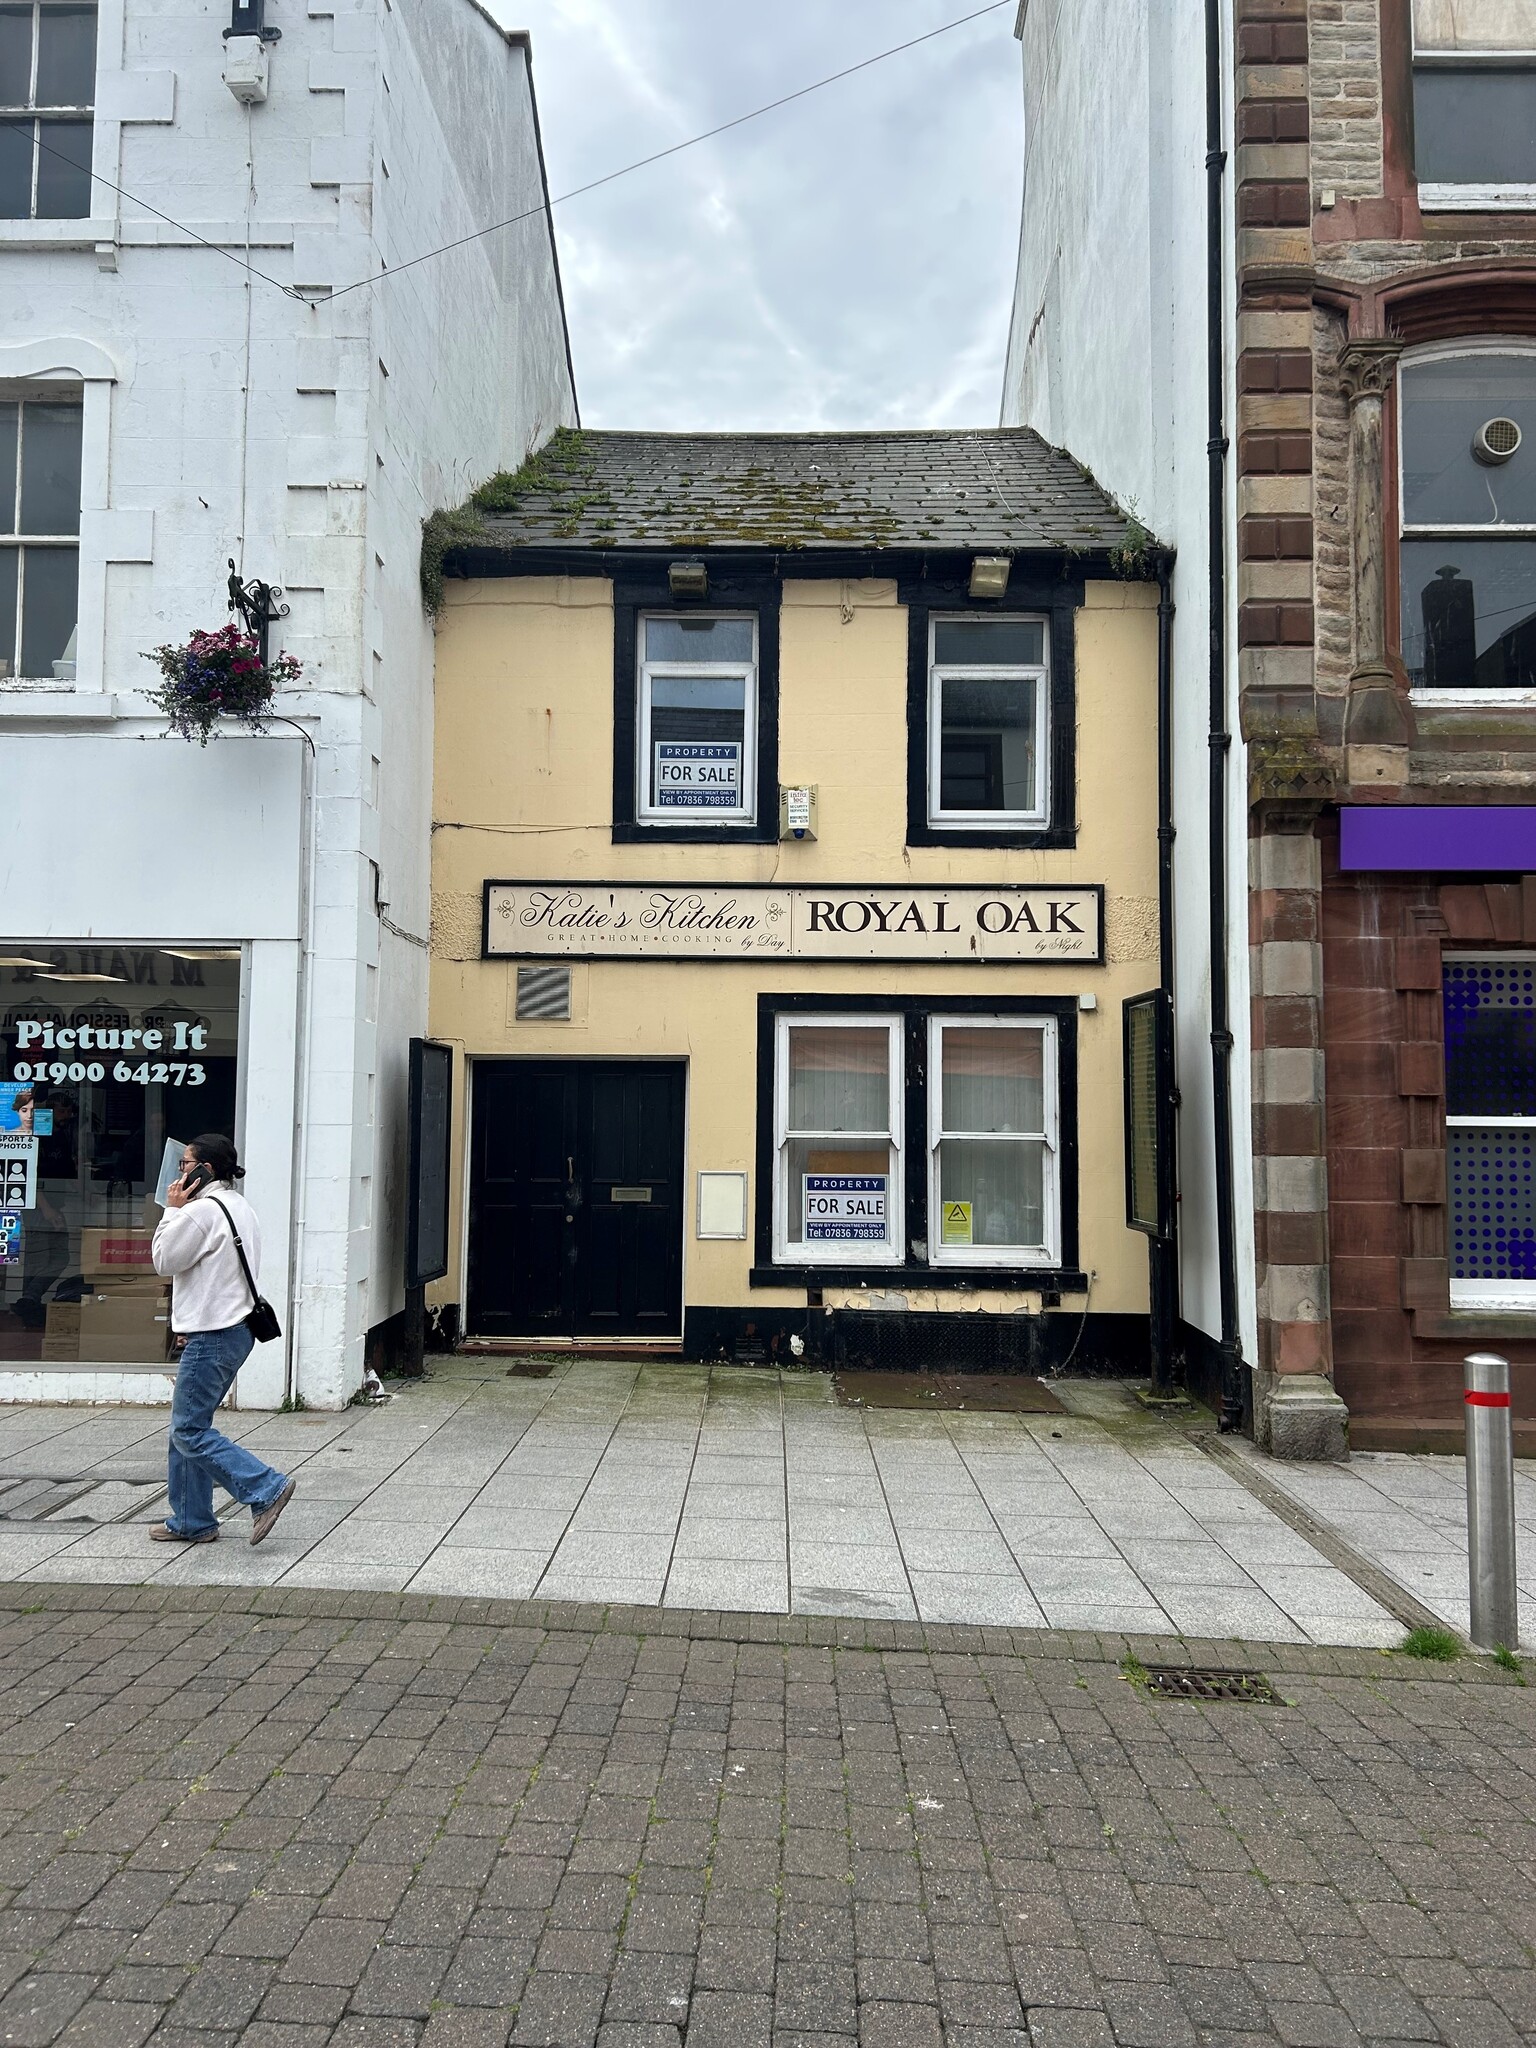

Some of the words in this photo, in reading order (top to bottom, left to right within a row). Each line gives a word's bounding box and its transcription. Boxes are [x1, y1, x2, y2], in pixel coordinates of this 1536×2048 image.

[666, 748, 731, 756] PROPERTY
[662, 766, 692, 780] FOR
[698, 767, 735, 782] SALE
[661, 796, 675, 804] Tel:
[677, 796, 703, 804] 07836
[705, 796, 736, 805] 798359
[520, 892, 632, 928] Katie's
[640, 893, 760, 930] Kitchen
[806, 900, 961, 933] ROYAL
[976, 901, 1085, 933] OAK
[547, 934, 597, 942] GREAT
[608, 934, 650, 942] HOME
[662, 934, 733, 943] COOKING
[740, 935, 755, 950] by
[756, 932, 786, 949] Day
[1035, 939, 1048, 954] by
[1049, 937, 1083, 954] Night
[15, 1020, 164, 1050] Picture
[173, 1021, 208, 1050] It
[13, 1061, 106, 1085] 01900
[112, 1060, 207, 1086] 64273
[813, 1180, 878, 1188] PROPERTY
[808, 1198, 839, 1213] FOR
[846, 1200, 884, 1215] SALE
[808, 1229, 823, 1237] Tel:
[825, 1229, 851, 1238] 07836
[853, 1229, 885, 1238] 798359
